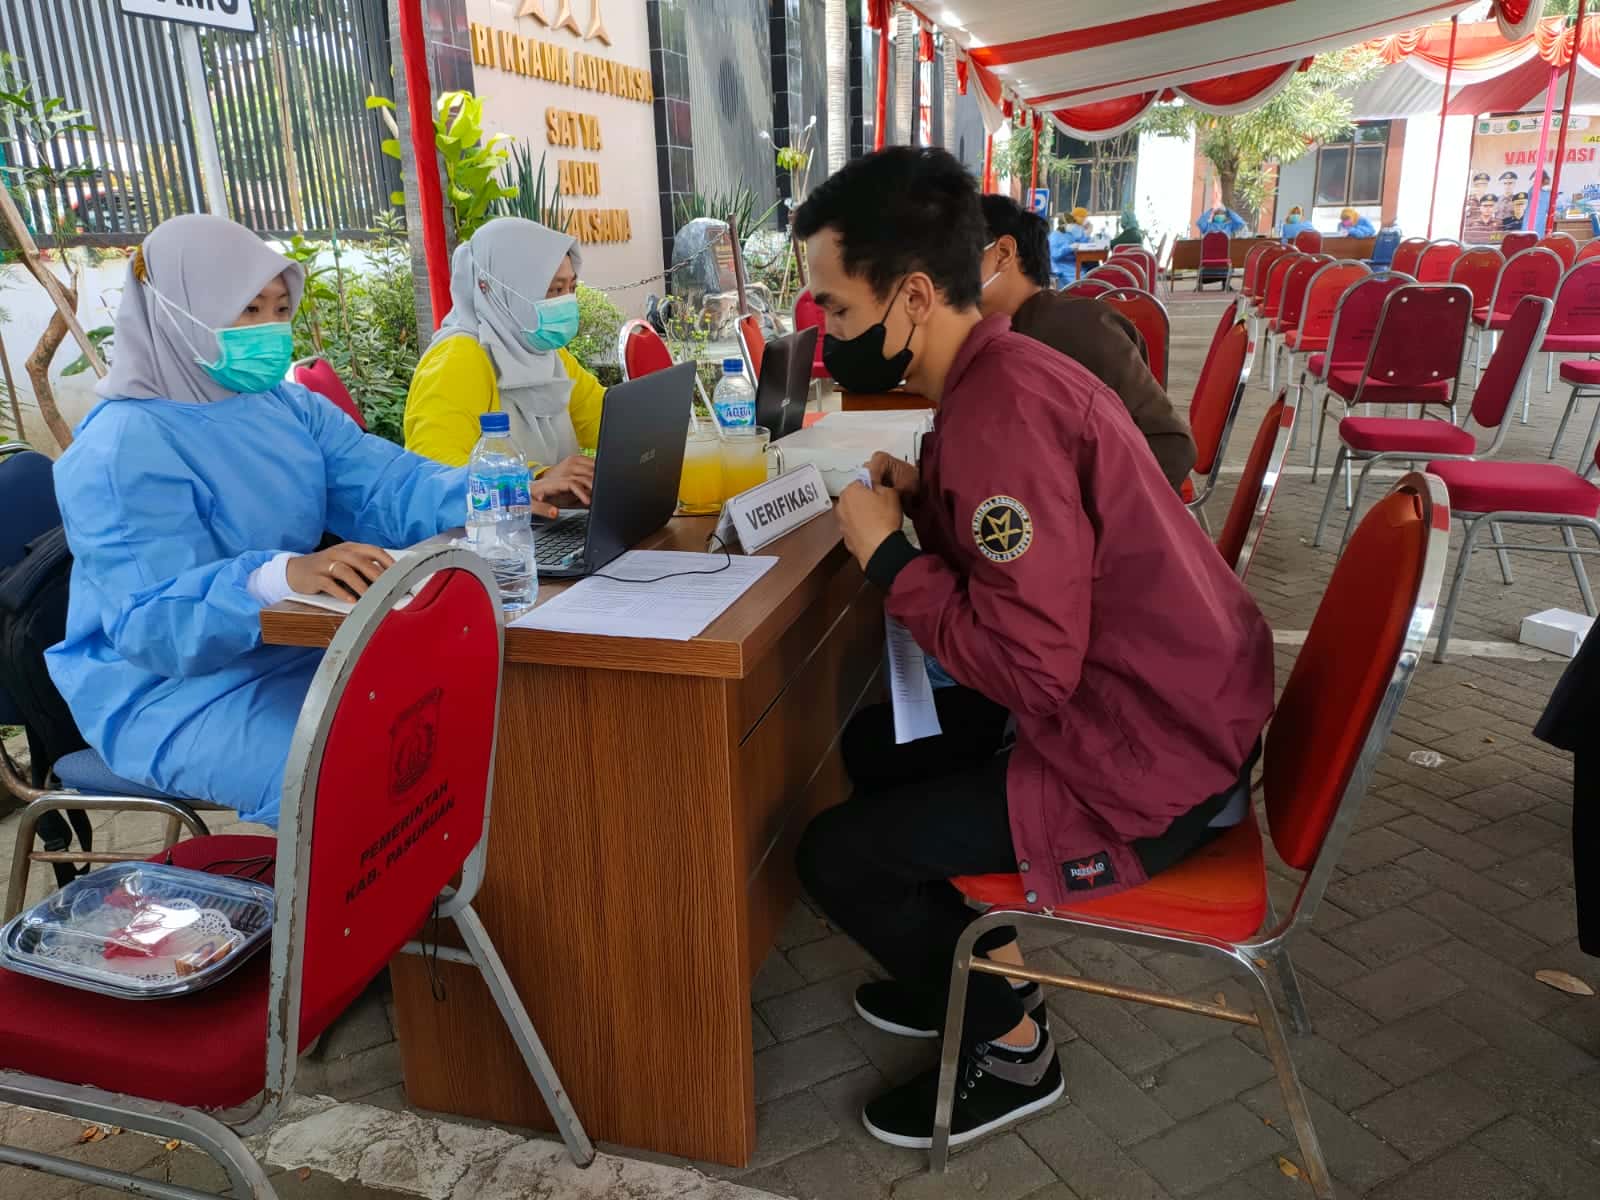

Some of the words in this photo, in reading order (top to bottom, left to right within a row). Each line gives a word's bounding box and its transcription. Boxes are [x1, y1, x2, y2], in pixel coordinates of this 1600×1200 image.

[498, 30, 574, 87] KRAMA
[574, 52, 654, 104] ADHYAKSA
[545, 106, 603, 150] SATYA
[558, 160, 600, 195] ADHI
[1504, 148, 1596, 165] VAKIASI
[745, 482, 819, 531] VERIFIKASI
[360, 778, 448, 866] PEMERINTAH
[386, 796, 455, 867] PASURUAN
